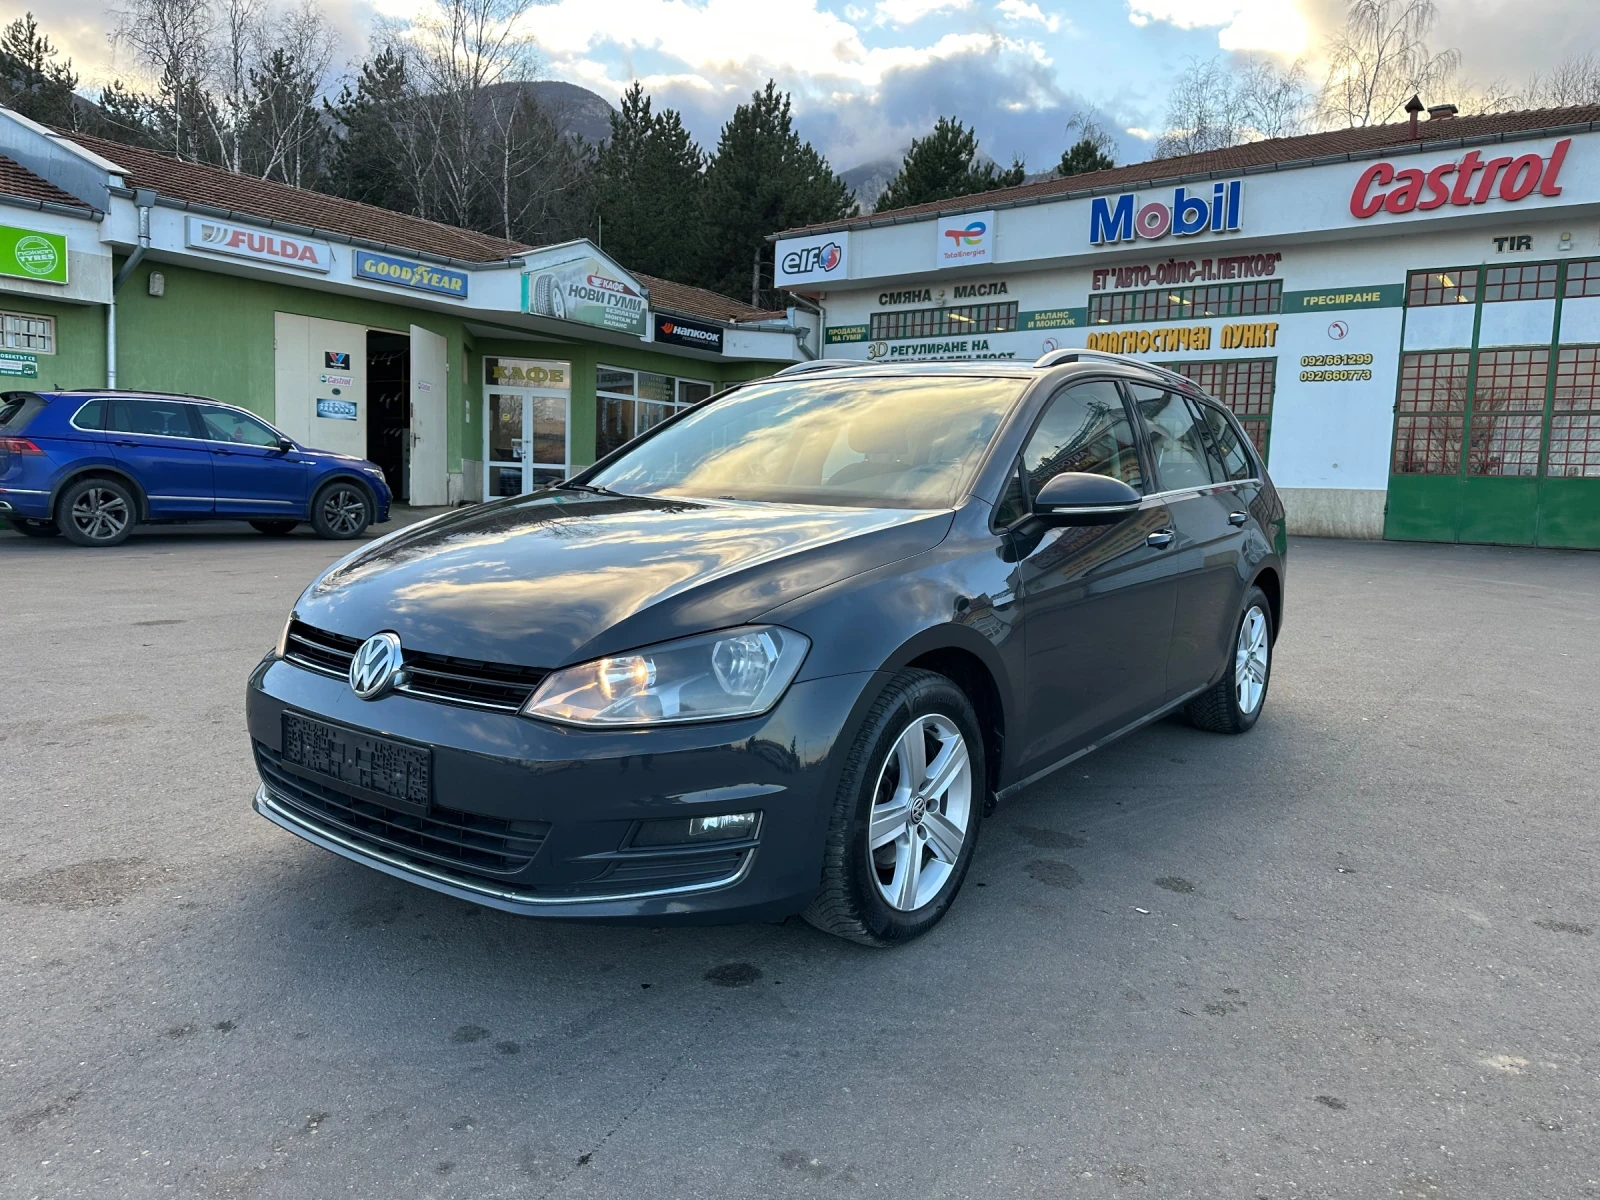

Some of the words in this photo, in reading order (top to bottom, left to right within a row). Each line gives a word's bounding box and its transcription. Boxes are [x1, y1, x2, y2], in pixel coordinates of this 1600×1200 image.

[1350, 138, 1572, 218] Castrol
[1089, 180, 1244, 246] Mobil
[225, 229, 319, 265] FULDA
[1492, 234, 1533, 253] TIR
[18, 253, 55, 262] TYRES
[781, 245, 822, 275] elf
[943, 248, 986, 260] TotalEnergies
[603, 280, 624, 292] КАФЕ
[1092, 268, 1110, 291] ЕТ
[568, 284, 605, 304] НОВИ
[607, 293, 642, 312] ГУМИ
[878, 288, 932, 306] СМЯНА
[953, 281, 1009, 299] МАСЛА
[1303, 292, 1381, 306] ГРЕСИРАНЕ
[604, 313, 631, 324] МОНТАЖ
[605, 307, 640, 320] БЕЗПЛАТЕН
[1035, 311, 1069, 321] БАЛАНС
[603, 319, 628, 329] БАЛАНС
[1027, 321, 1035, 329] И
[1036, 318, 1075, 328] МОНТАЖ
[828, 326, 866, 336] ПРОДАЖБА
[842, 333, 862, 341] ГУМИ
[1220, 322, 1279, 349] ПУНКТ
[867, 341, 888, 360] 3D
[890, 341, 968, 356] РЕГУЛИРАНЕ
[971, 339, 989, 351] НА
[1300, 353, 1373, 367] 092/661299
[327, 376, 352, 385] Castrol
[492, 366, 564, 383] КАФЕ
[1299, 369, 1372, 382] 092/660773
